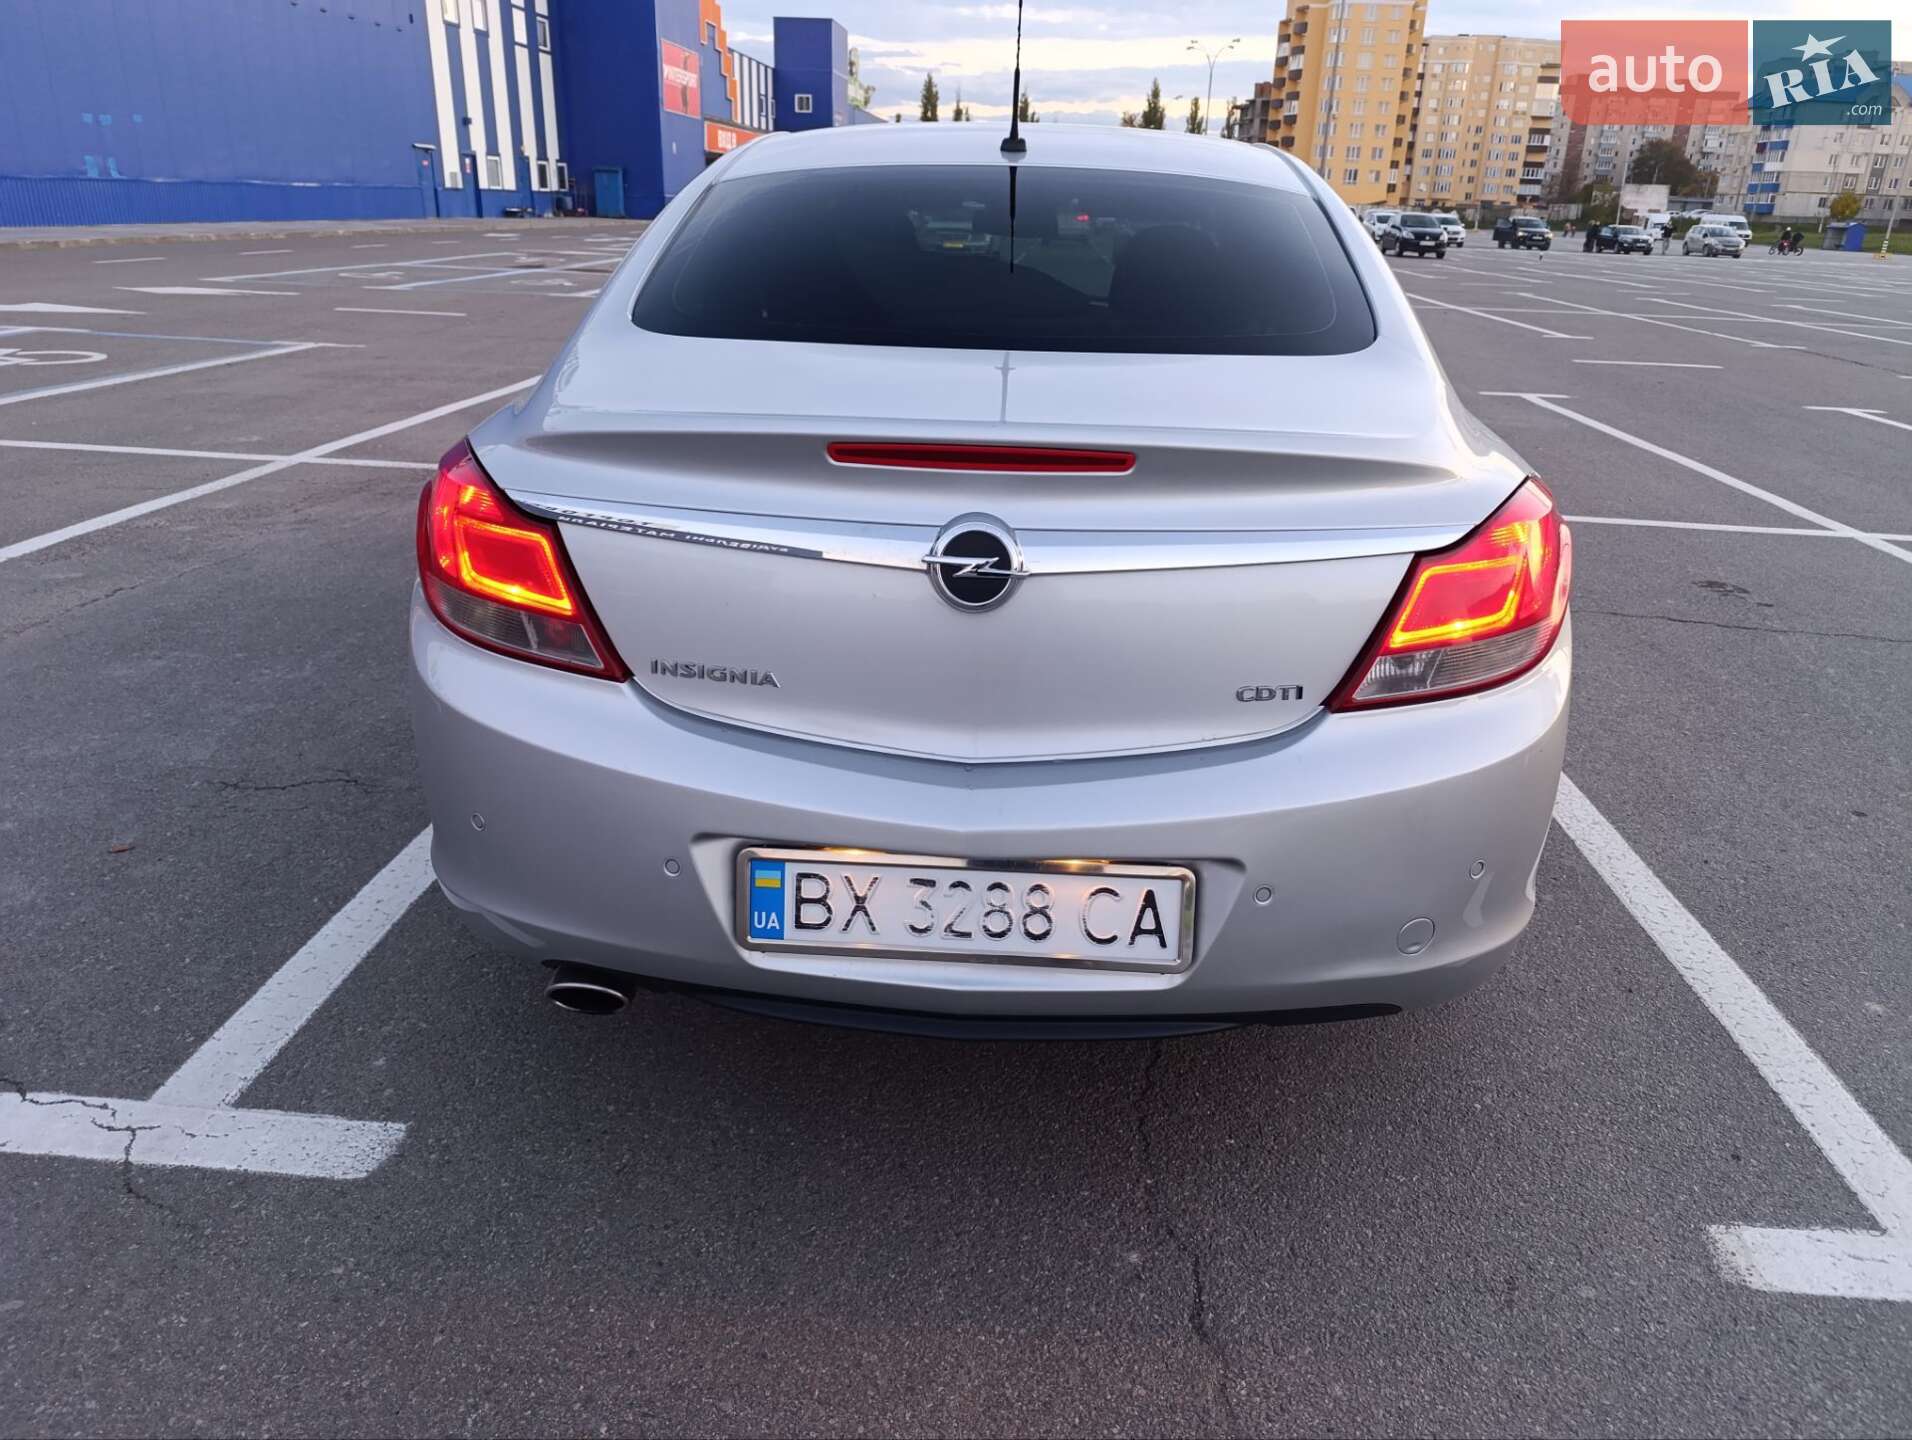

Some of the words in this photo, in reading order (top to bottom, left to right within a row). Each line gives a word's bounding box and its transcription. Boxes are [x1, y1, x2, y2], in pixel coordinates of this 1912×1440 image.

[651, 659, 782, 688] INSIGNIA
[754, 911, 780, 930] UA
[904, 877, 1056, 943] 3288
